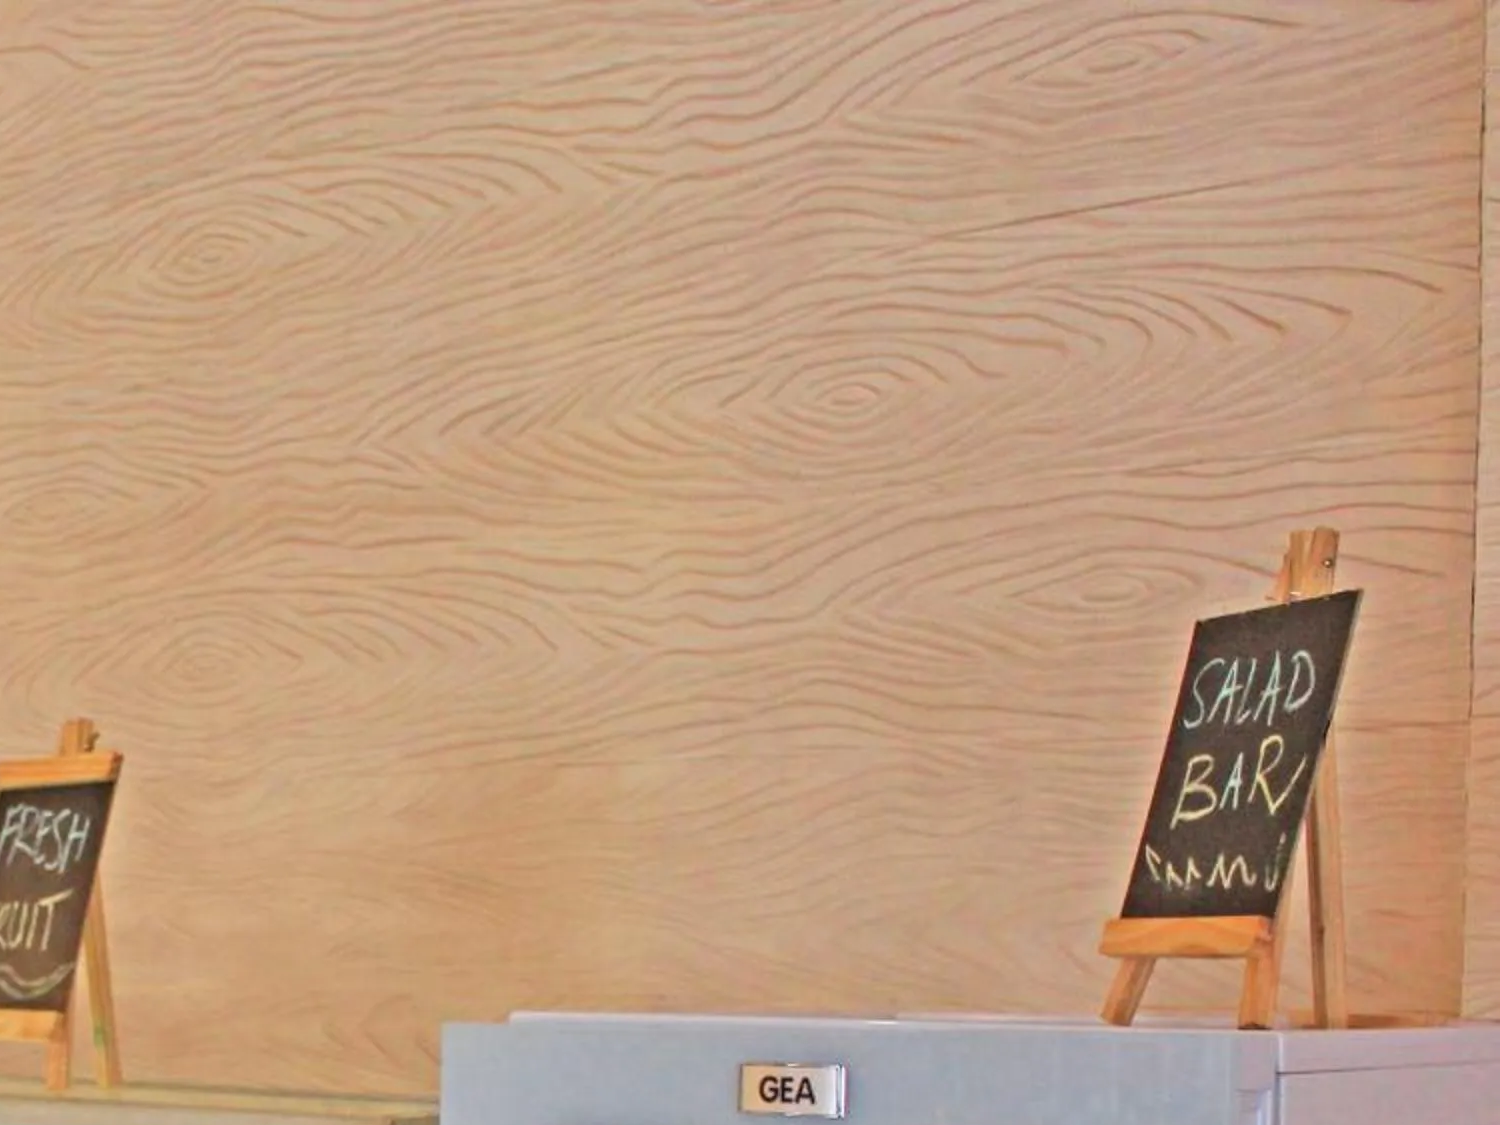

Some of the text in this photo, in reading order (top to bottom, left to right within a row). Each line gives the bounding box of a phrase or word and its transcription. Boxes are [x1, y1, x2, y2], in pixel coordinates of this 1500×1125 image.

[1183, 649, 1317, 729] SALAD
[1170, 734, 1308, 830] BAR
[758, 1075, 816, 1105] GEA
